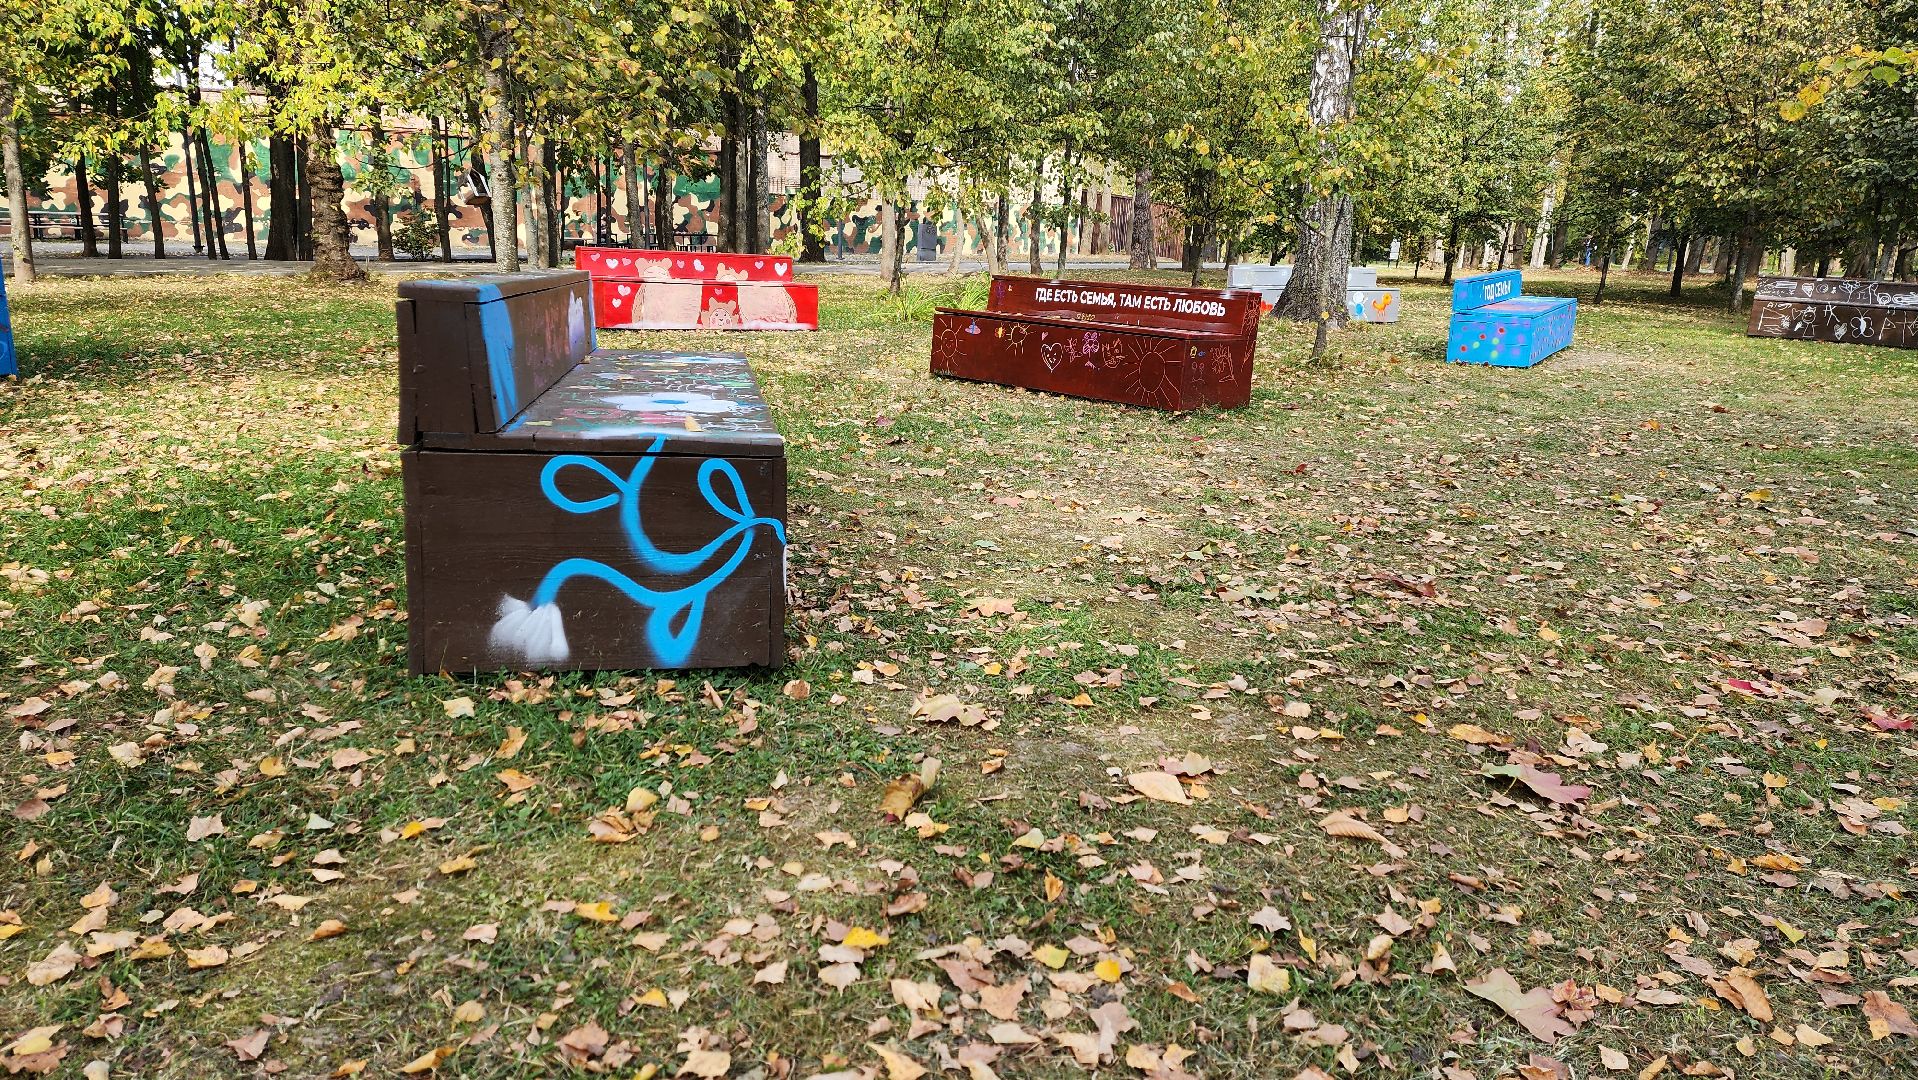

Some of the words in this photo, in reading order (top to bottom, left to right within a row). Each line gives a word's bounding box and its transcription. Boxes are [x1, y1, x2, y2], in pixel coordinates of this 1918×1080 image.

[1035, 287, 1053, 303] ГДЕ
[1053, 288, 1078, 304] ЕСТЬ
[1080, 290, 1117, 308] СЕМЬЯ,
[1119, 293, 1142, 309] ТАМ
[1144, 295, 1171, 311] ЕСТЬ
[1173, 298, 1226, 317] ЛЮБОВЬ
[1484, 283, 1494, 300] ГОД
